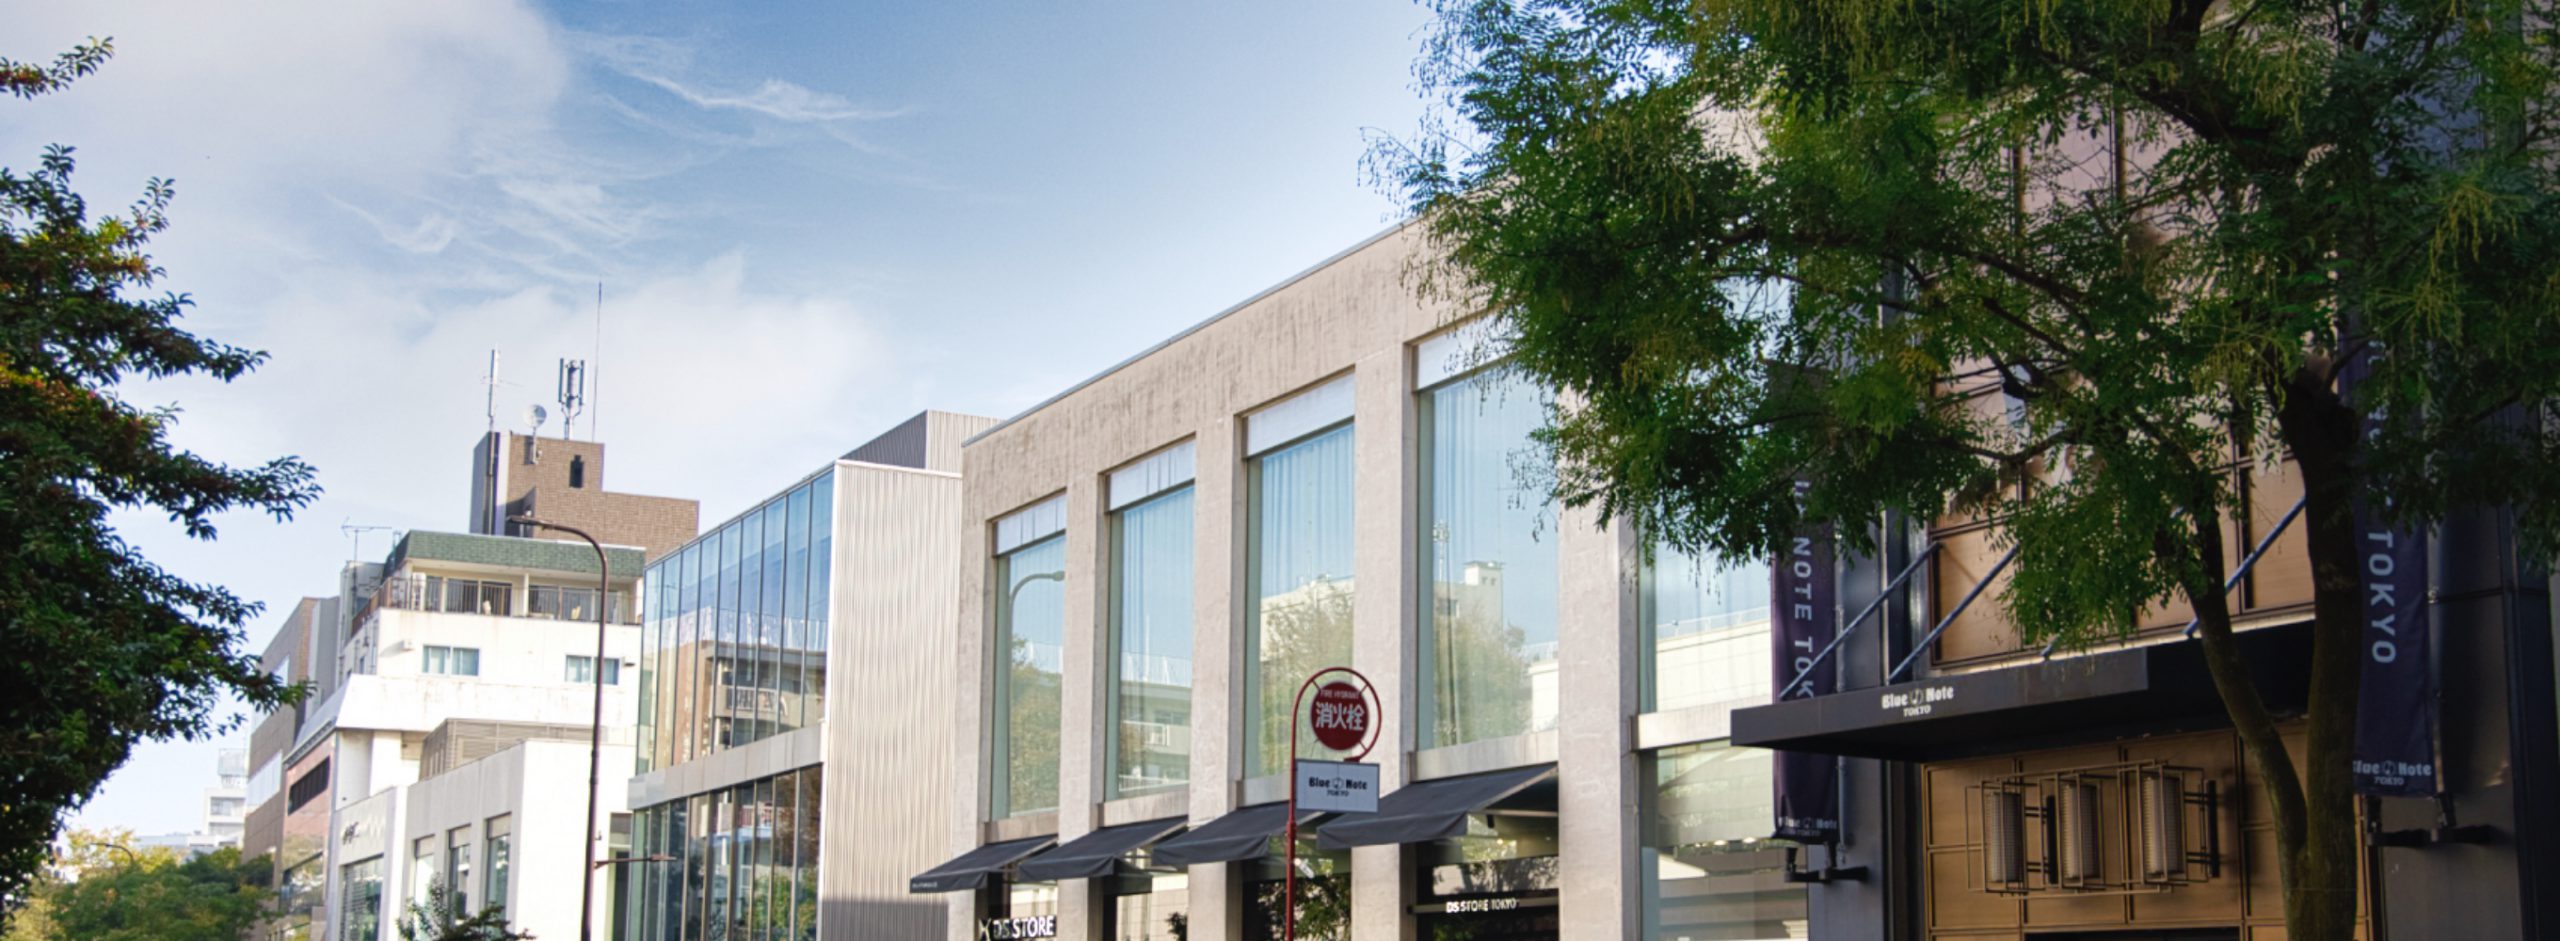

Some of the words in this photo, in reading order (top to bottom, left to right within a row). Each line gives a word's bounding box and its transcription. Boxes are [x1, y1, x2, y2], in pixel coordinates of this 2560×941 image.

[1793, 536, 1813, 622] NOTE
[2367, 530, 2397, 664] TOKYO
[1794, 636, 1814, 698] TOK
[1319, 689, 1333, 698] FIRE
[1881, 694, 1908, 709] Blue
[1925, 686, 1954, 702] Note
[1315, 701, 1365, 731] 消火栓
[1903, 704, 1931, 717] TOKYO
[2398, 762, 2432, 776] Note
[1308, 777, 1331, 788] Blue
[1345, 779, 1368, 790] Note
[2374, 776, 2405, 786] TOKYO
[1446, 901, 1460, 913] DS
[1460, 899, 1489, 912] STORE
[993, 919, 1010, 939] DS
[1012, 914, 1055, 939] STORE
